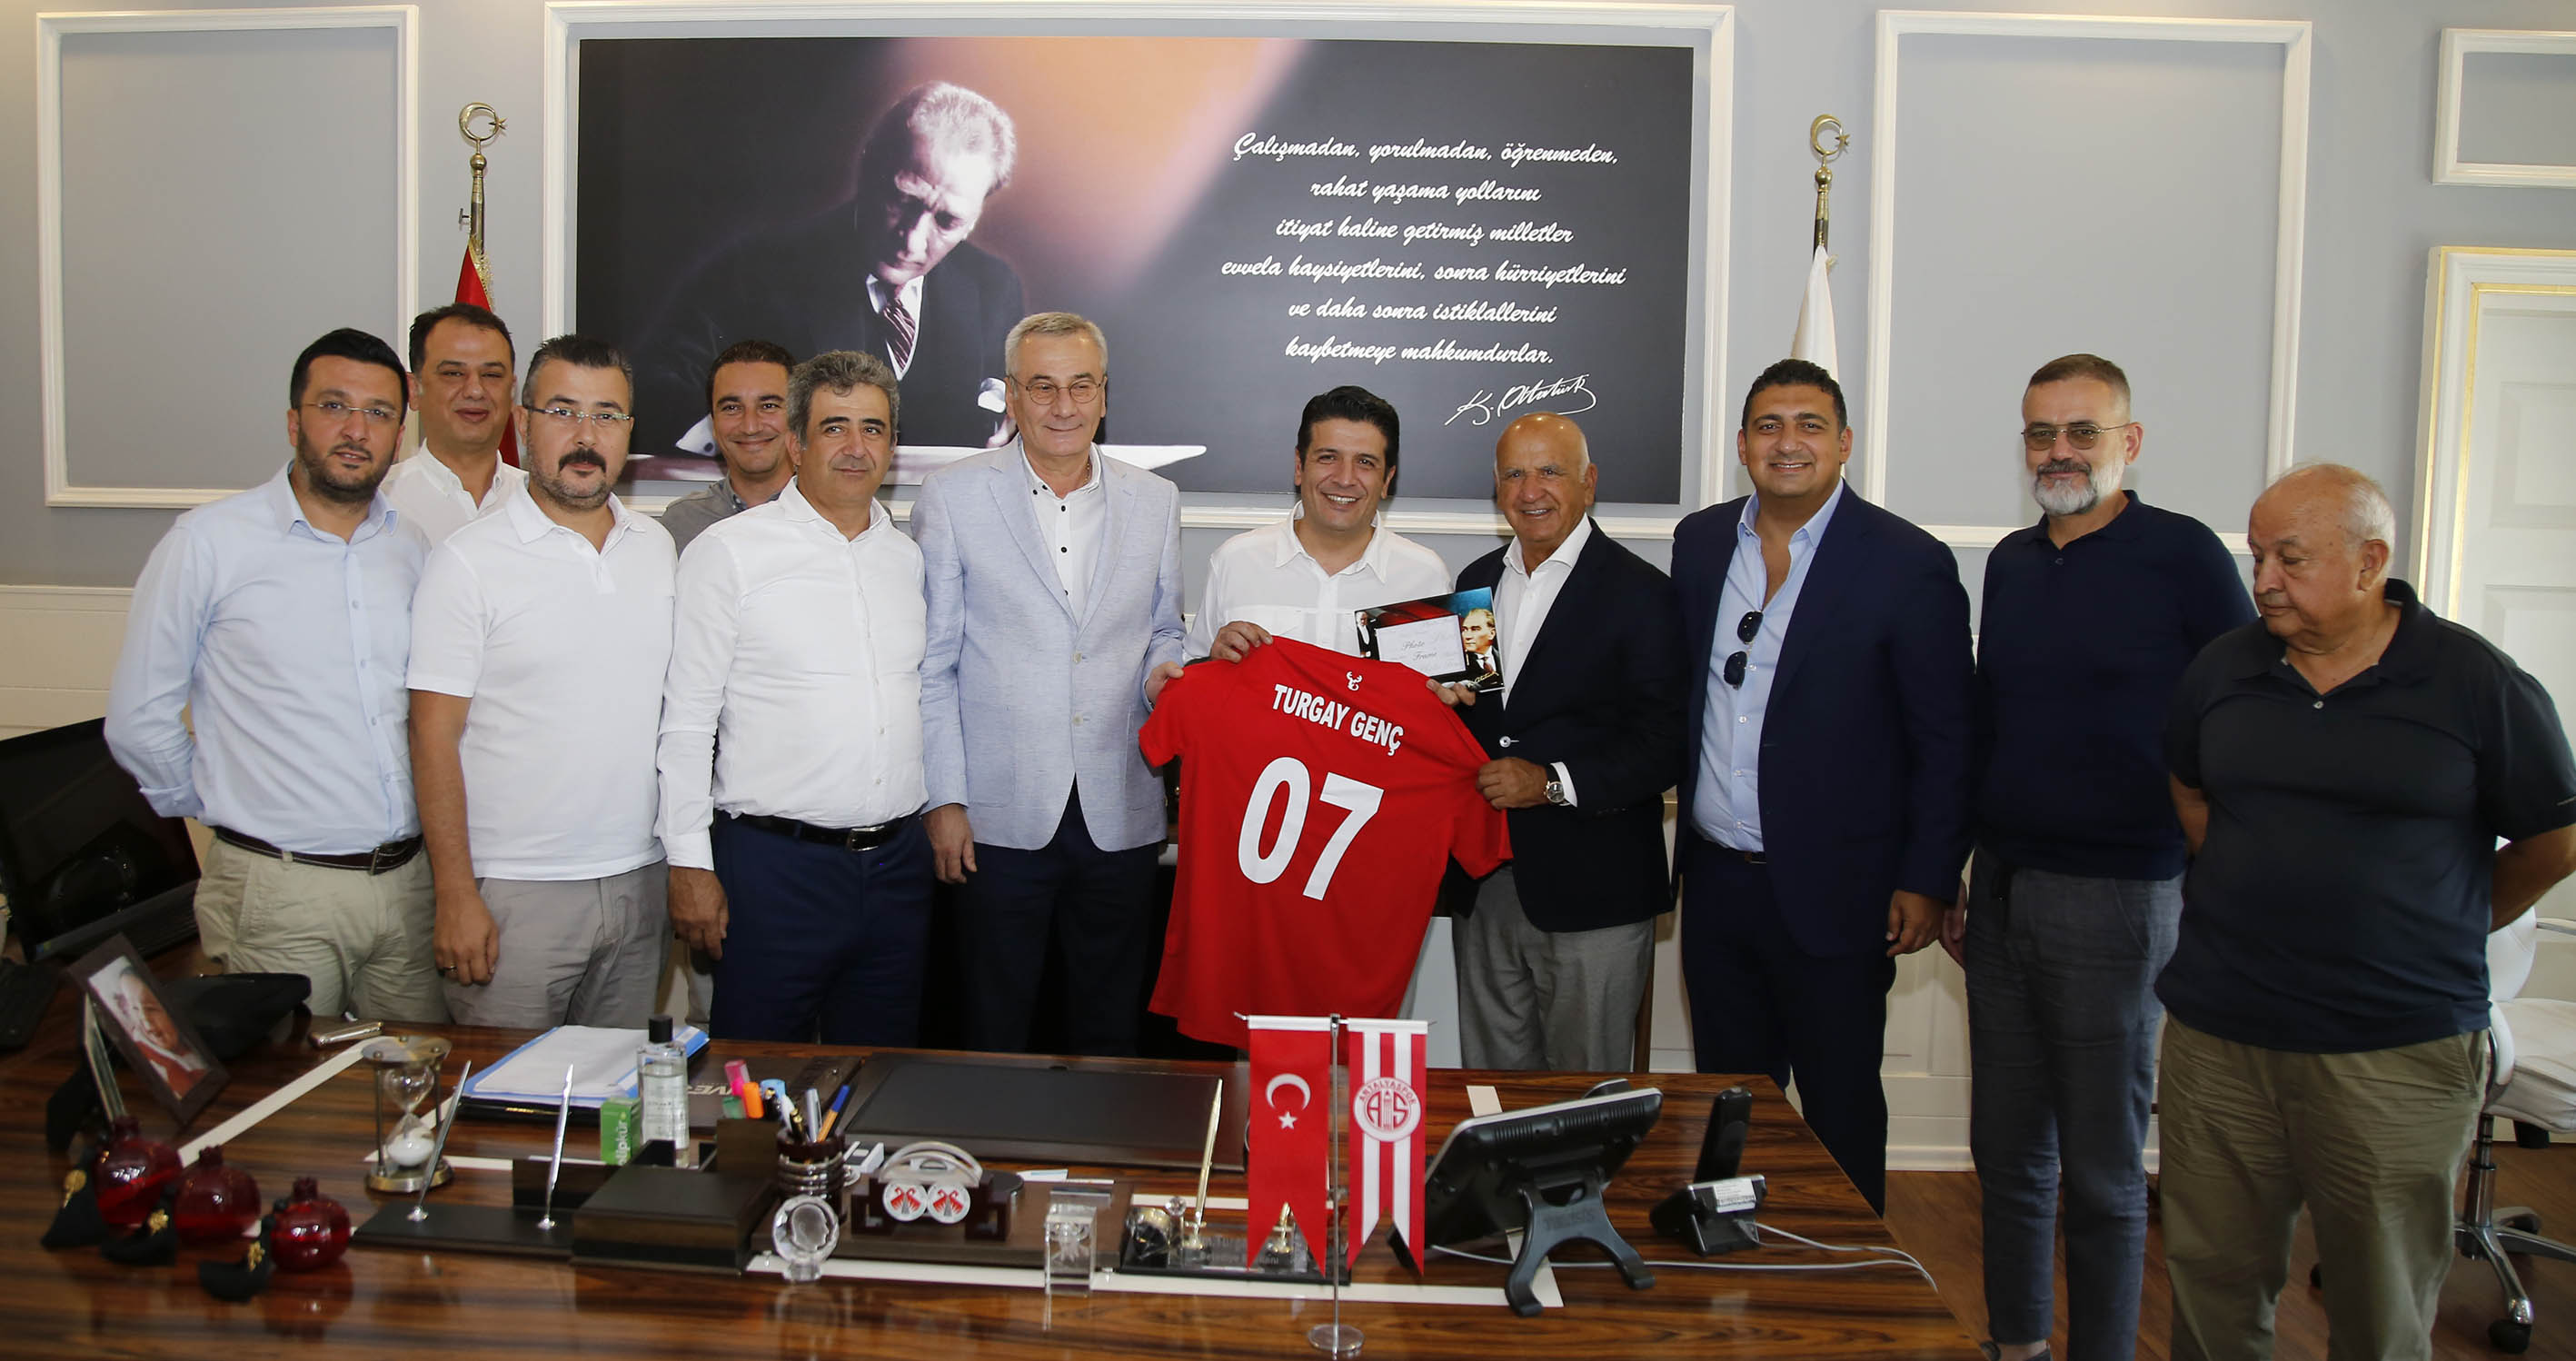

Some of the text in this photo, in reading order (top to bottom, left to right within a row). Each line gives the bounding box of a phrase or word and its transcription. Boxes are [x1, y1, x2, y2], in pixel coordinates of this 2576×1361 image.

[1232, 132, 1618, 168] Çalışmadan, yorulmadan, öğrenmeden,
[1309, 174, 1542, 206] rahat yaşama yollarını
[1276, 215, 1575, 247] itiyat haline getirmiş milletler
[1221, 254, 1627, 289] evvela haysiyetlerini, sonra hürriyetlerini
[1288, 296, 1557, 323] ve daha sonra istiklallerini
[1285, 335, 1554, 365] kaybetmeye mahkumdurlar.
[1272, 683, 1405, 757] TURGAY GENÇ
[1238, 756, 1385, 901] 07
[1359, 1079, 1417, 1106] ANTALYASPOR
